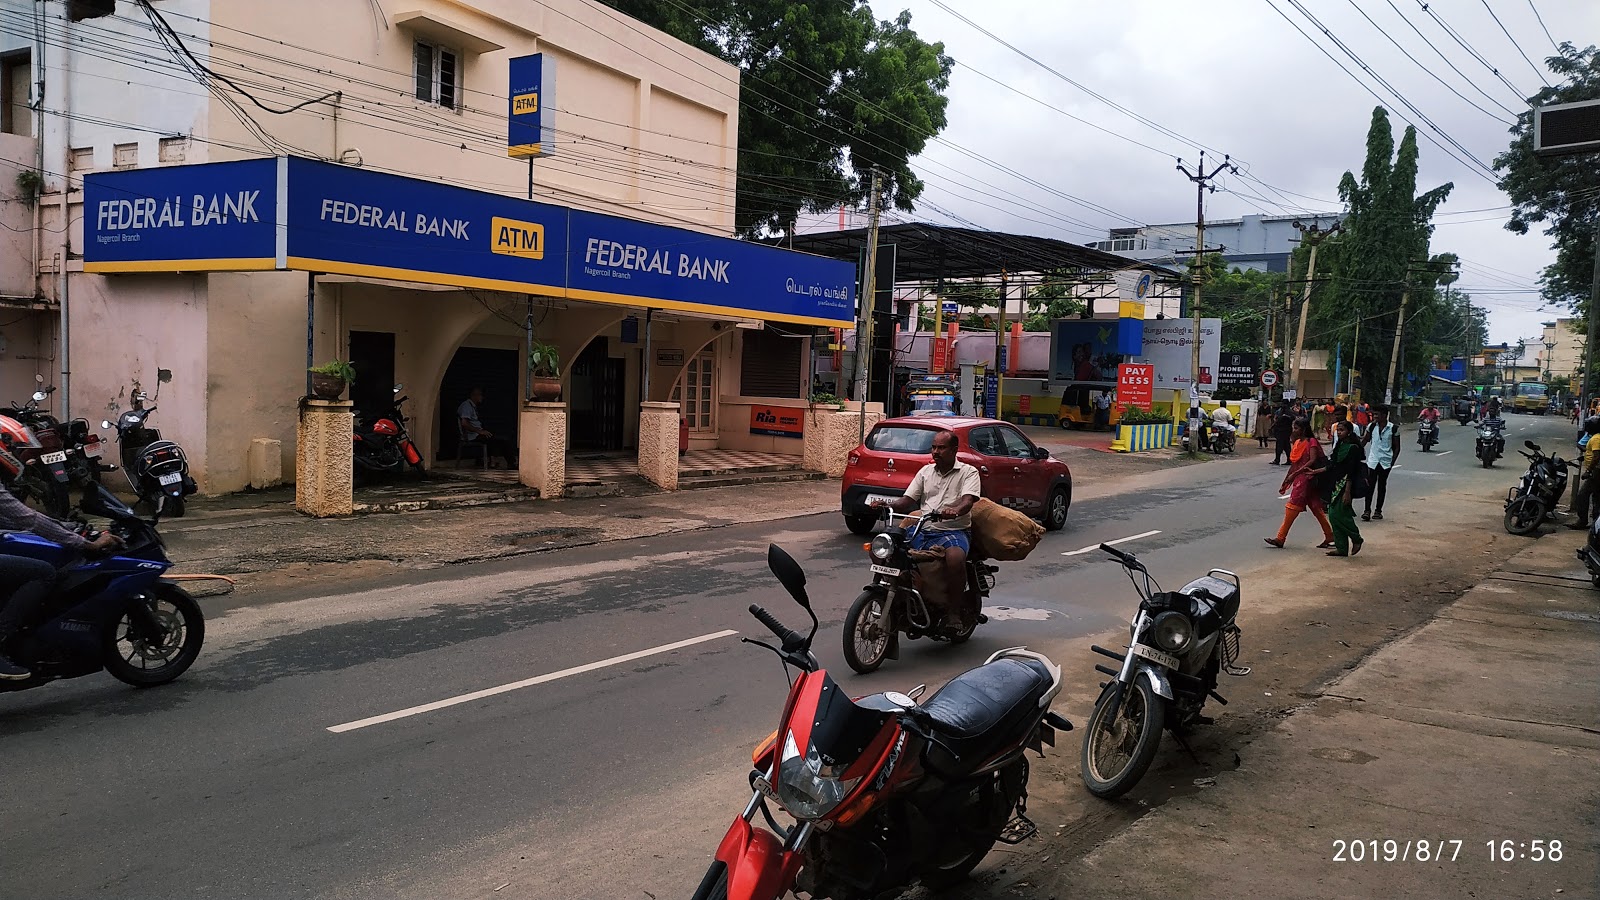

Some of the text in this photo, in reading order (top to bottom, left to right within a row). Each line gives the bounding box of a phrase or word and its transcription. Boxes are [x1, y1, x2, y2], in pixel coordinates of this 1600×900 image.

[516, 98, 534, 110] ATM
[97, 190, 260, 230] FEDERAL BANK
[320, 199, 470, 240] FEDERAL BANK
[97, 233, 140, 244] Nagercoil Branch
[498, 226, 538, 250] ATM
[585, 238, 730, 284] FEDERAL BANK
[584, 266, 630, 279] Nagercoil Branch
[786, 278, 848, 300] பெடரல் வங்கி
[756, 410, 776, 424] Ria
[822, 754, 836, 764] TVS
